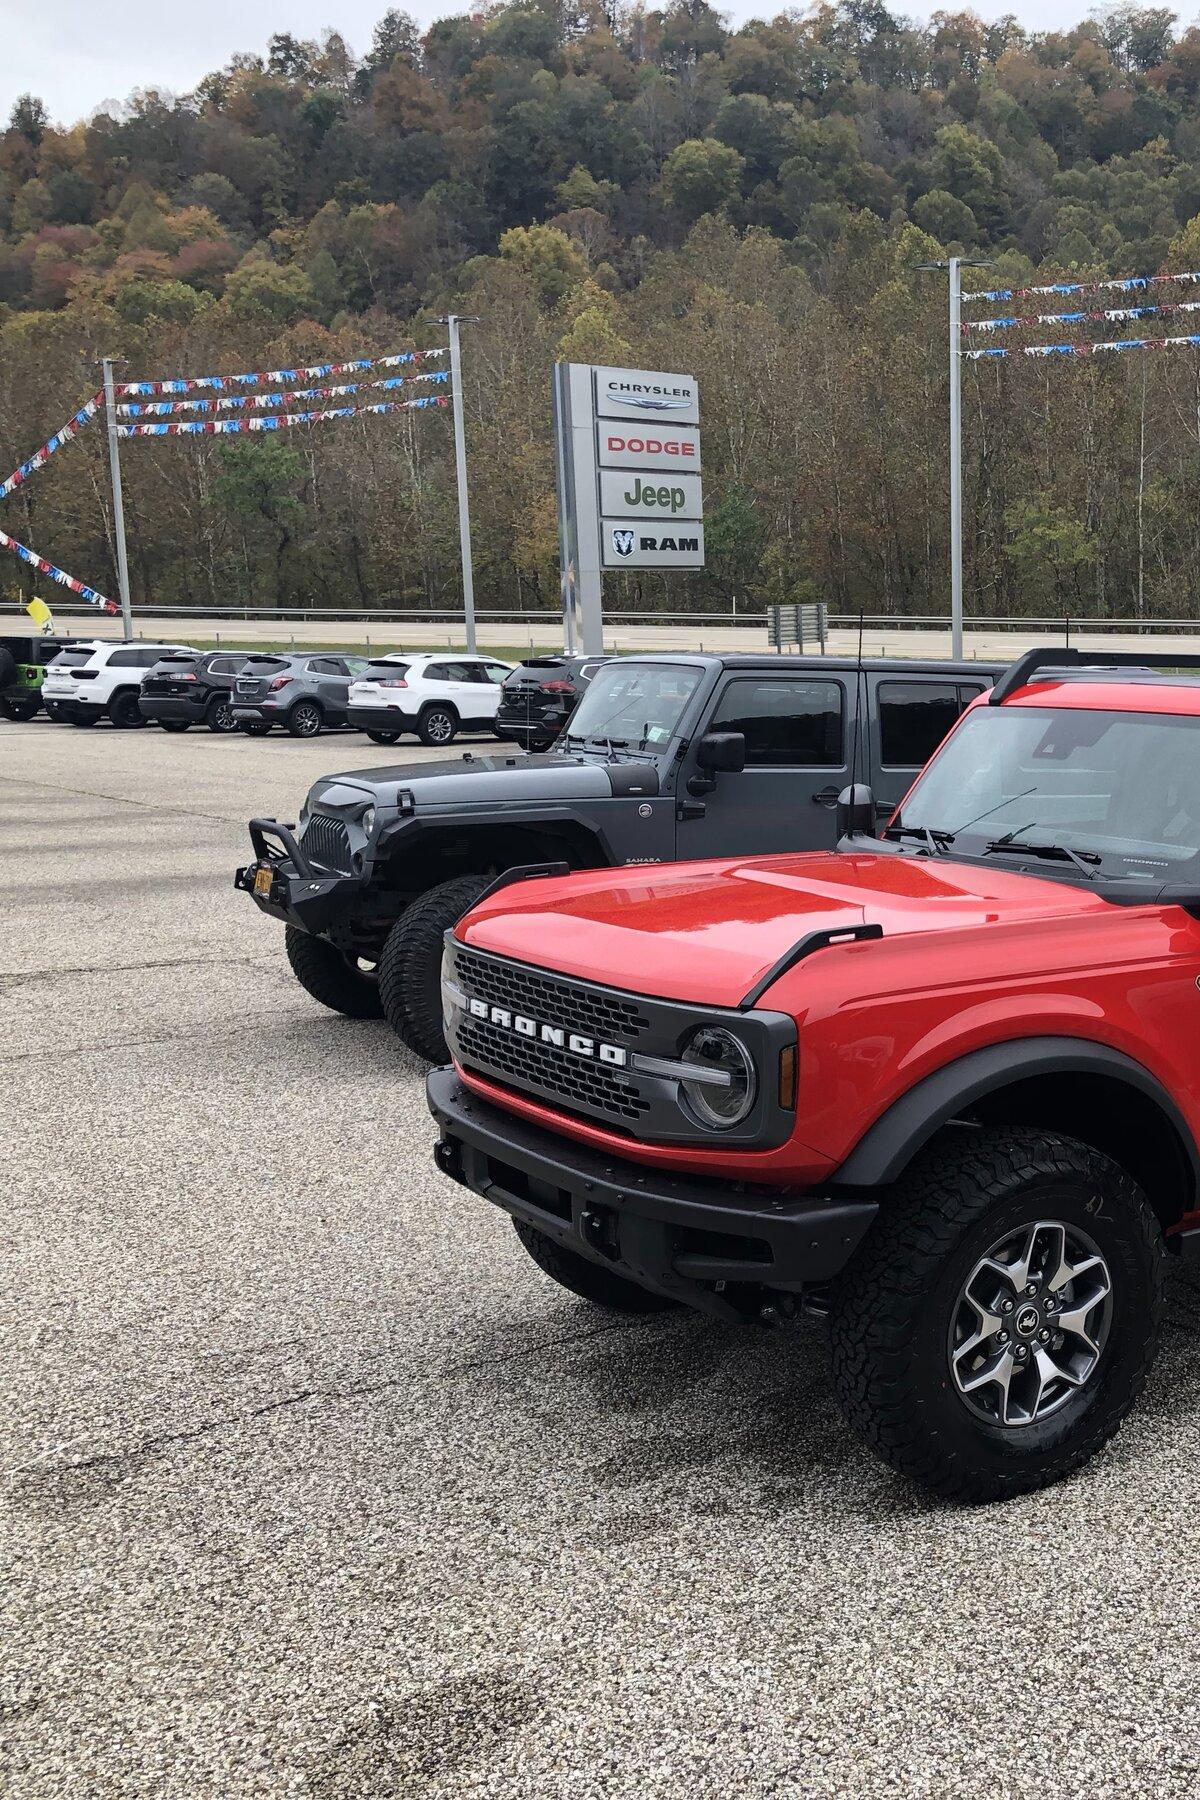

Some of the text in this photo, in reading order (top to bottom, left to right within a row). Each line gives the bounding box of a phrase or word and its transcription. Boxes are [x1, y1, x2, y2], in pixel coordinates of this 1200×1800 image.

[608, 382, 691, 397] CHRYSLER
[607, 437, 695, 457] DODGE
[624, 478, 685, 513] Jeep
[640, 537, 699, 552] RAM
[470, 998, 627, 1066] BRONCO
